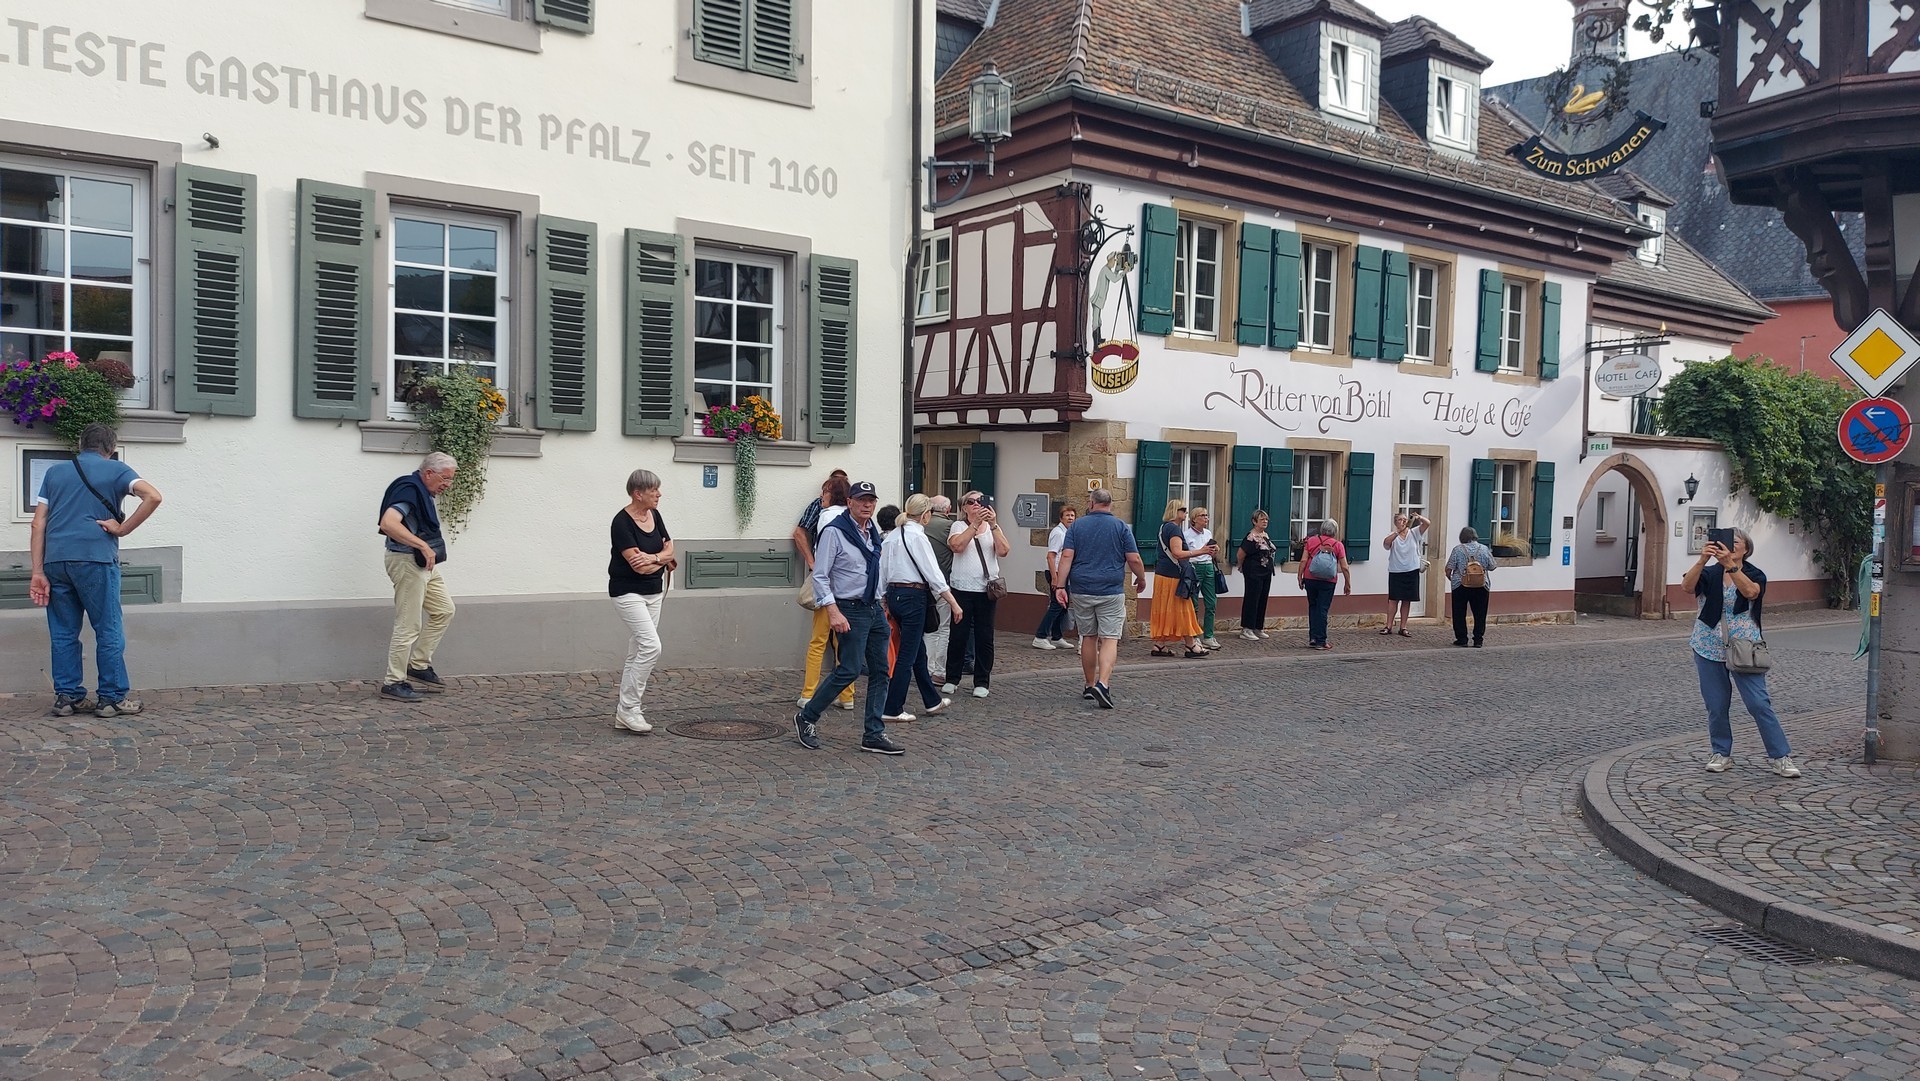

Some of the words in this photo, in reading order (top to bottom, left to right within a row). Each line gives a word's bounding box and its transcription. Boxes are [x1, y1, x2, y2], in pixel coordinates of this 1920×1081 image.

[0, 17, 167, 88] TESTE
[186, 50, 428, 130] GASTHAUS
[443, 96, 523, 147] DER
[538, 112, 651, 168] PFALZ
[687, 140, 756, 185] SEIT
[768, 157, 838, 199] 1160
[1525, 145, 1563, 176] Zum
[1565, 125, 1652, 177] Schwanen
[1092, 364, 1138, 388] MUSEUM
[1204, 361, 1307, 432] Ritter
[1597, 372, 1629, 383] HOTEL
[1634, 368, 1659, 380] CAFÉ
[1313, 394, 1341, 417] von
[1318, 374, 1391, 434] Böhl
[1423, 390, 1479, 437] Hotel
[1483, 402, 1496, 427] &
[1500, 396, 1533, 438] Café
[1590, 443, 1609, 451] FREI
